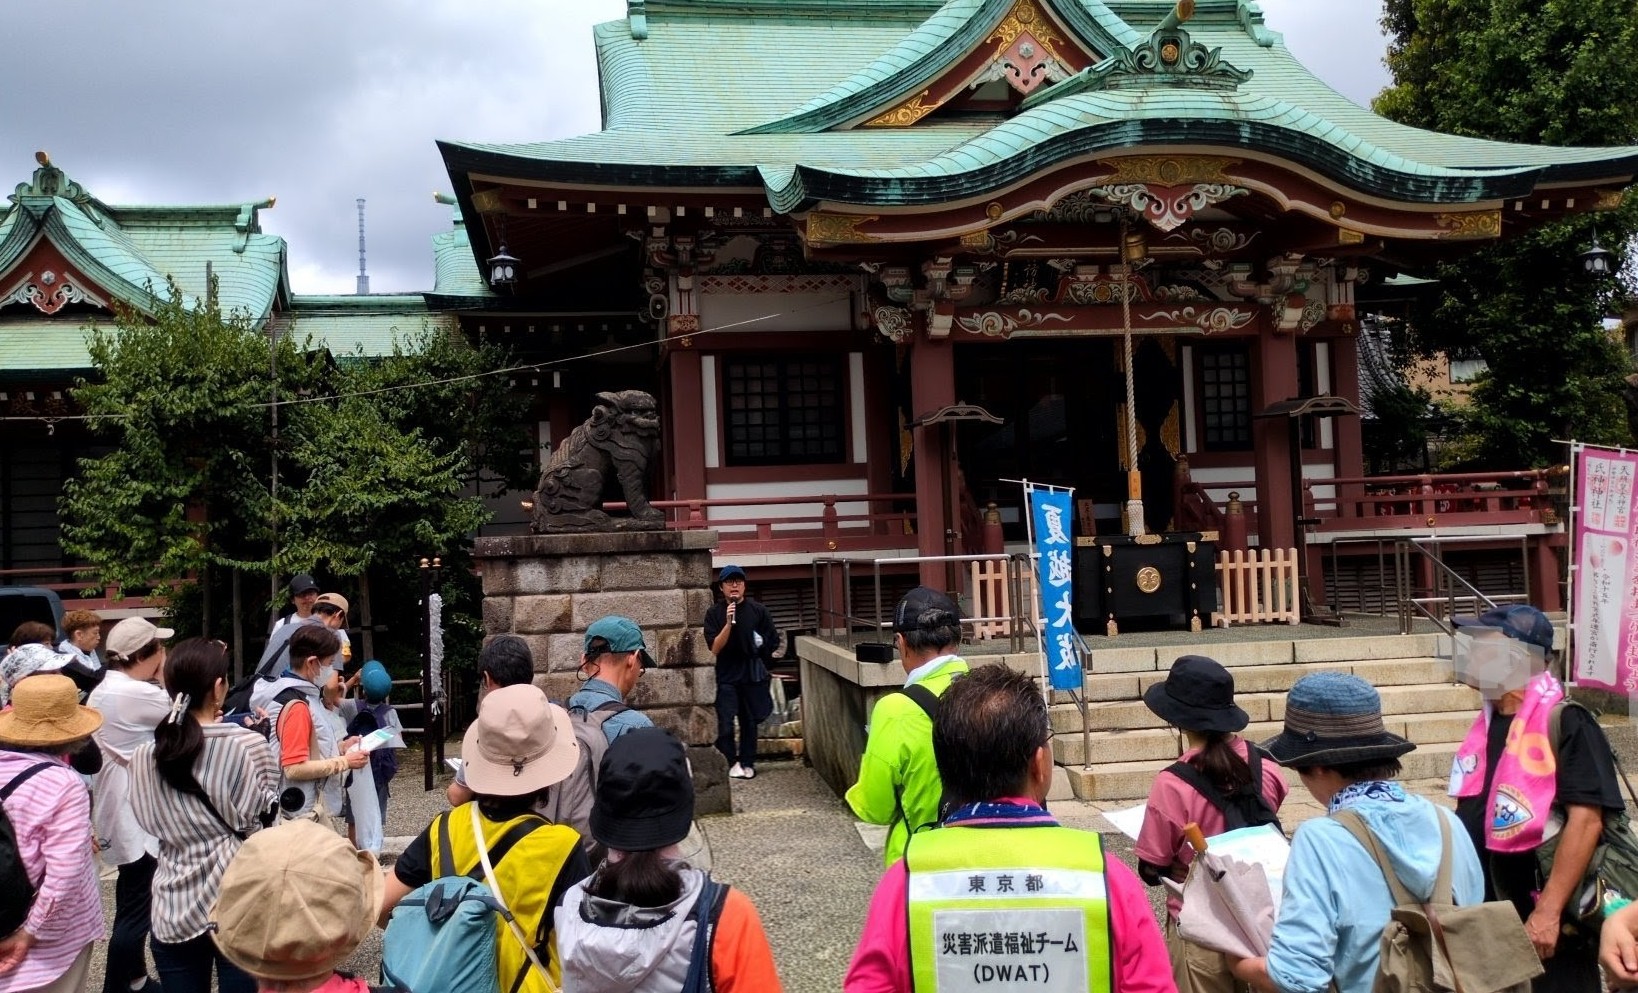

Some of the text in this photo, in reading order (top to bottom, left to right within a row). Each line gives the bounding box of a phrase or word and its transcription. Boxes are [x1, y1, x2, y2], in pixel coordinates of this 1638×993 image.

[968, 874, 1044, 893] 東京都
[942, 932, 1079, 955] 災害派遣福祉チーム
[974, 963, 1049, 984] (DWAT)
